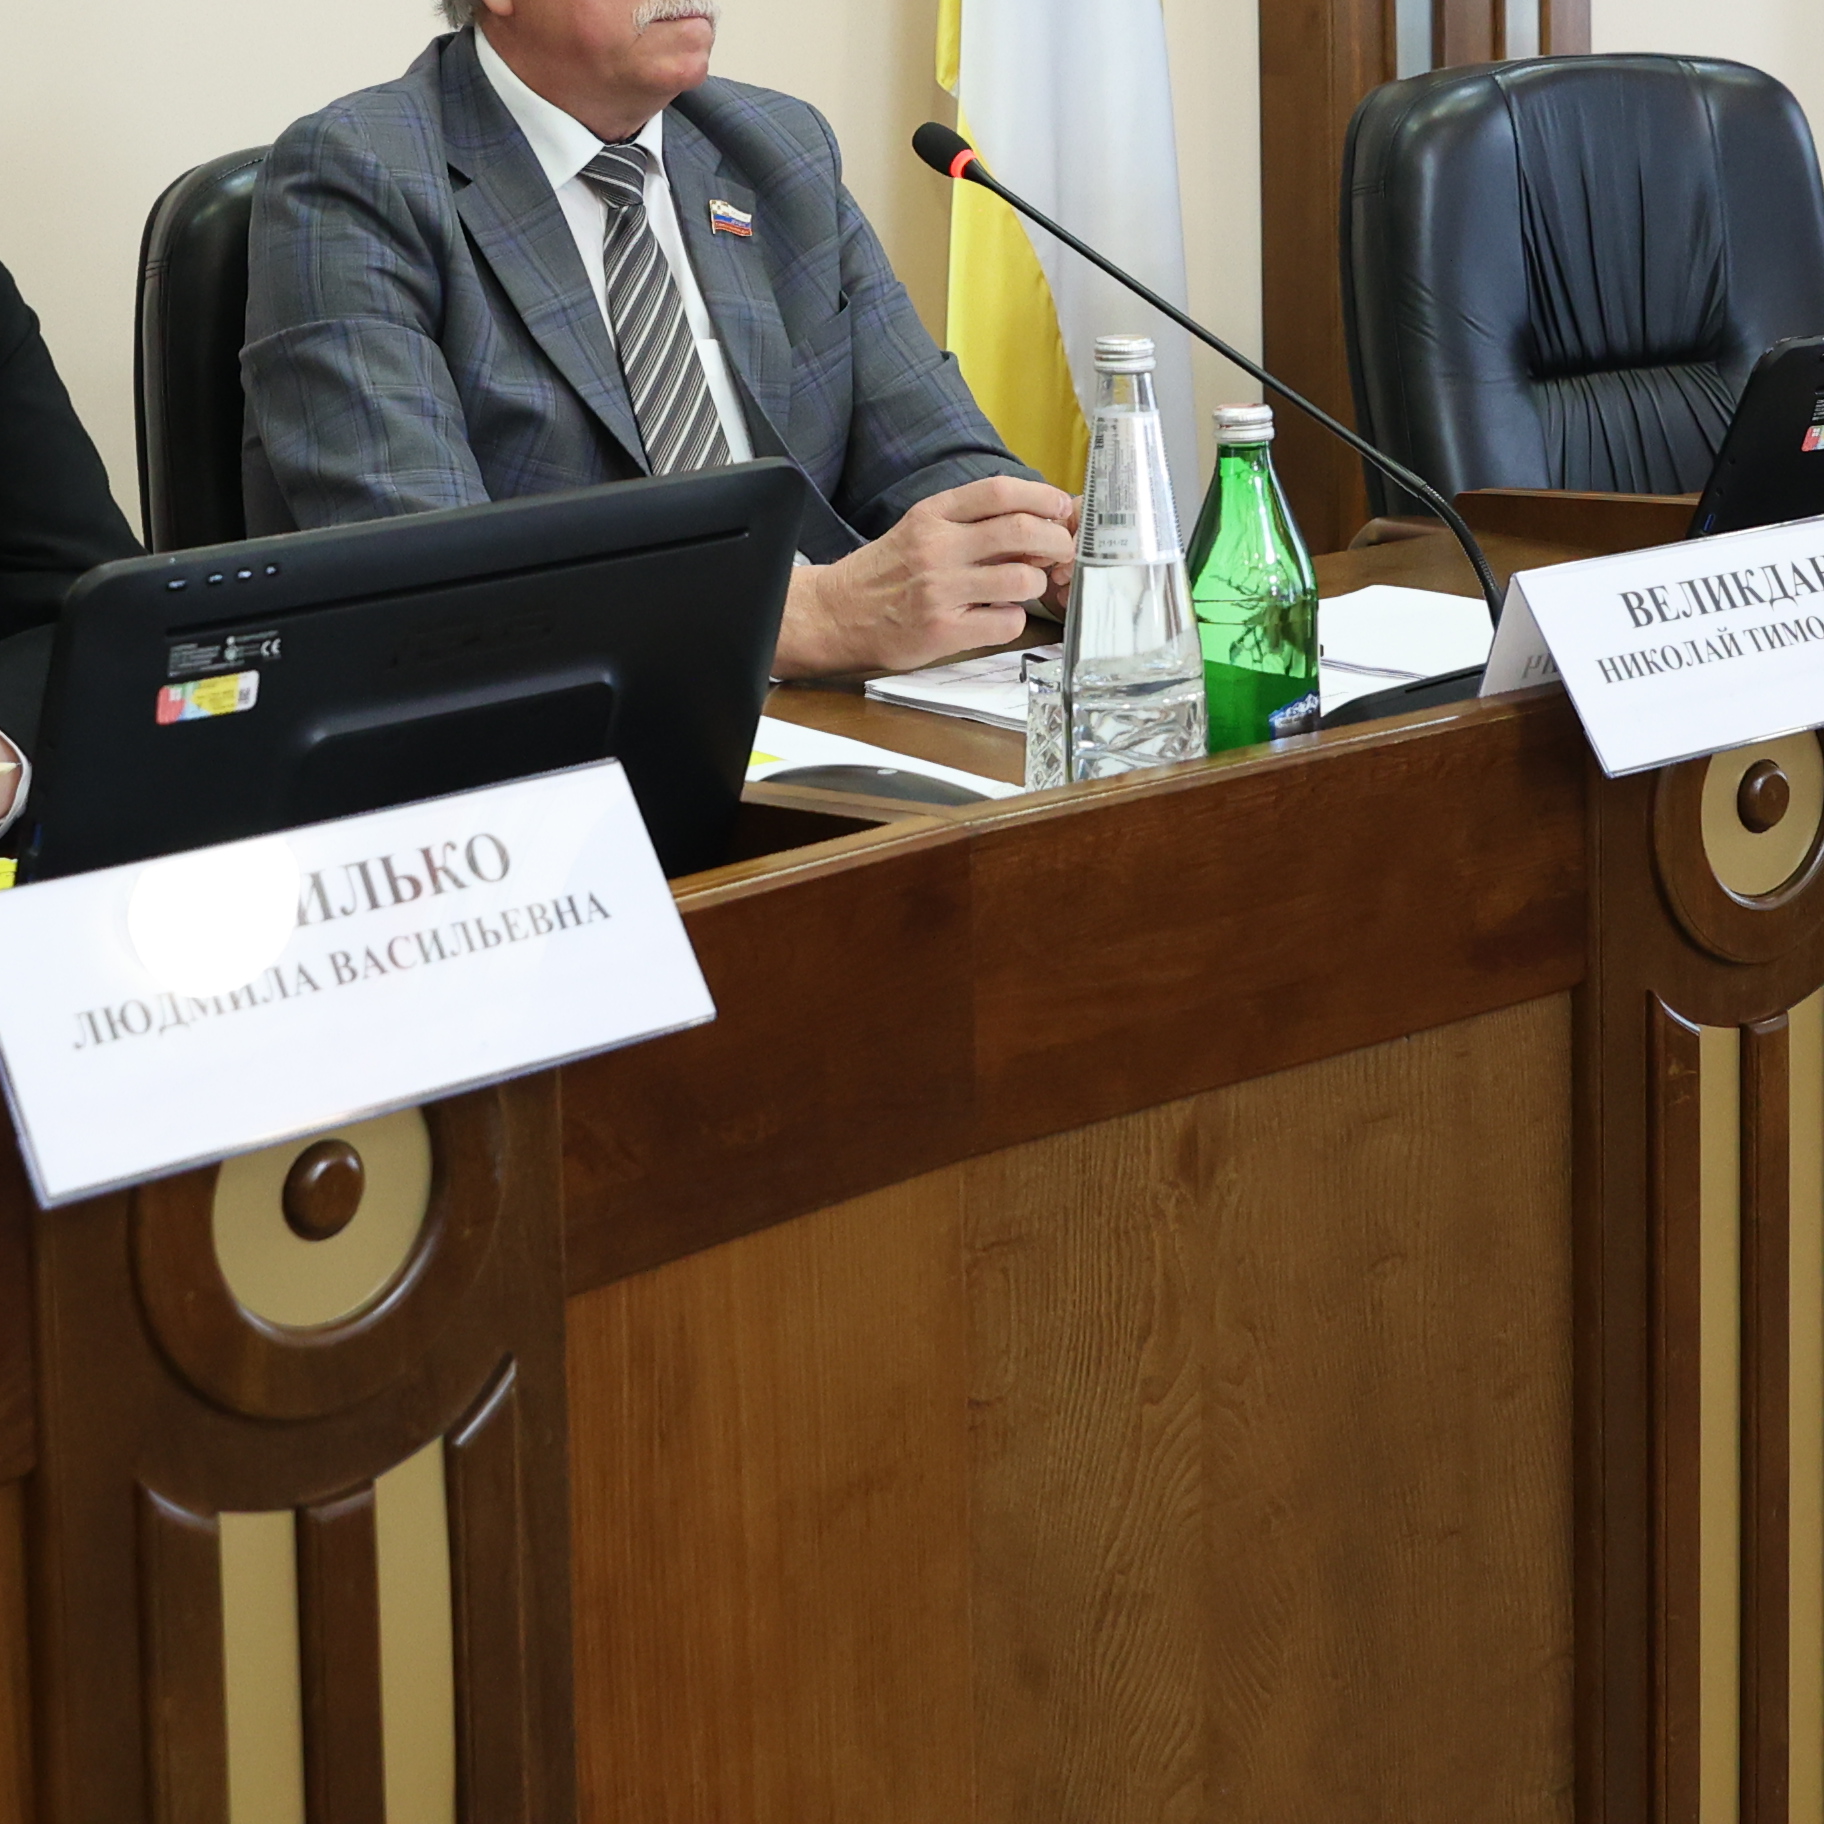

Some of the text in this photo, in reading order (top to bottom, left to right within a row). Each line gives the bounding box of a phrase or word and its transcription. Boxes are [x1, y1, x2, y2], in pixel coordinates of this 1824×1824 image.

[1595, 627, 1746, 685] НИКОЛАЙ
[295, 833, 511, 929] ИЛЬКО
[329, 890, 612, 987] ВАСИЛЬЕВНА
